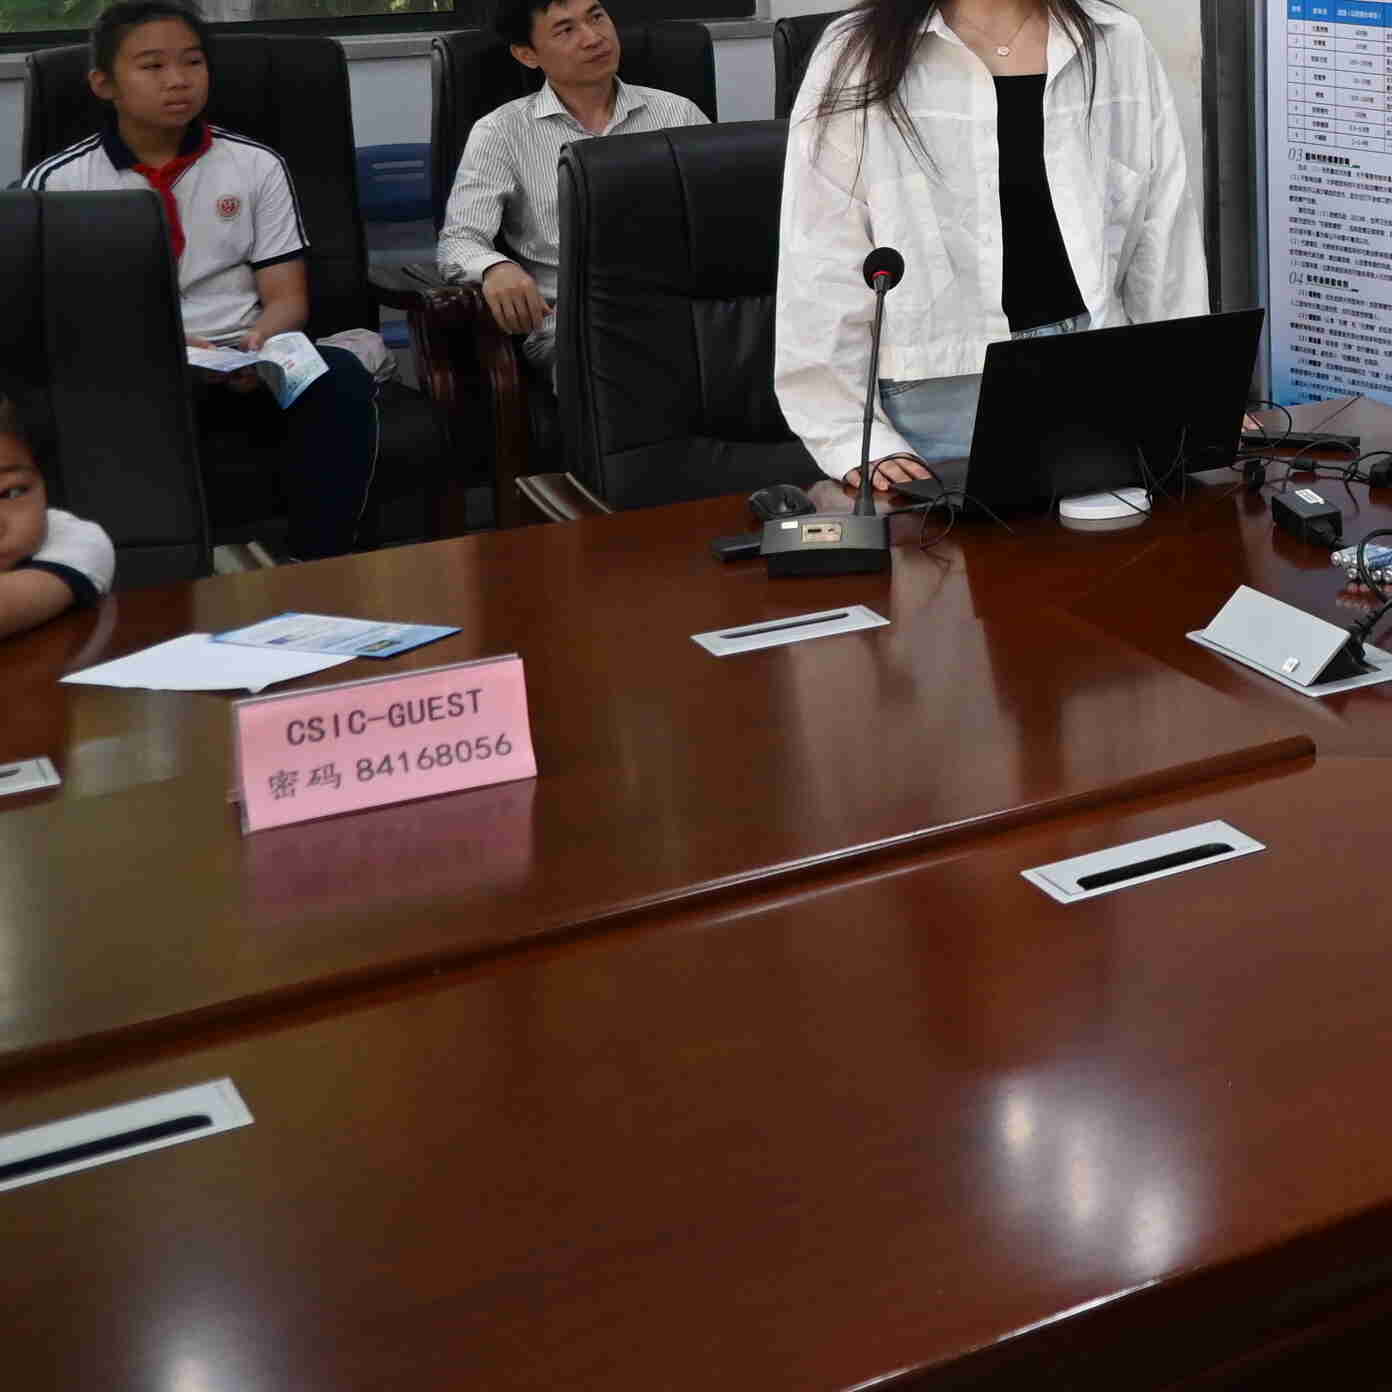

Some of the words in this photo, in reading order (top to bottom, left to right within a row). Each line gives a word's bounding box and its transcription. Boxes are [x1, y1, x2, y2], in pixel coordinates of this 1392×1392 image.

[286, 688, 483, 747] CSIC-GUEST
[268, 762, 343, 801] 密码
[356, 732, 514, 783] 84168056
